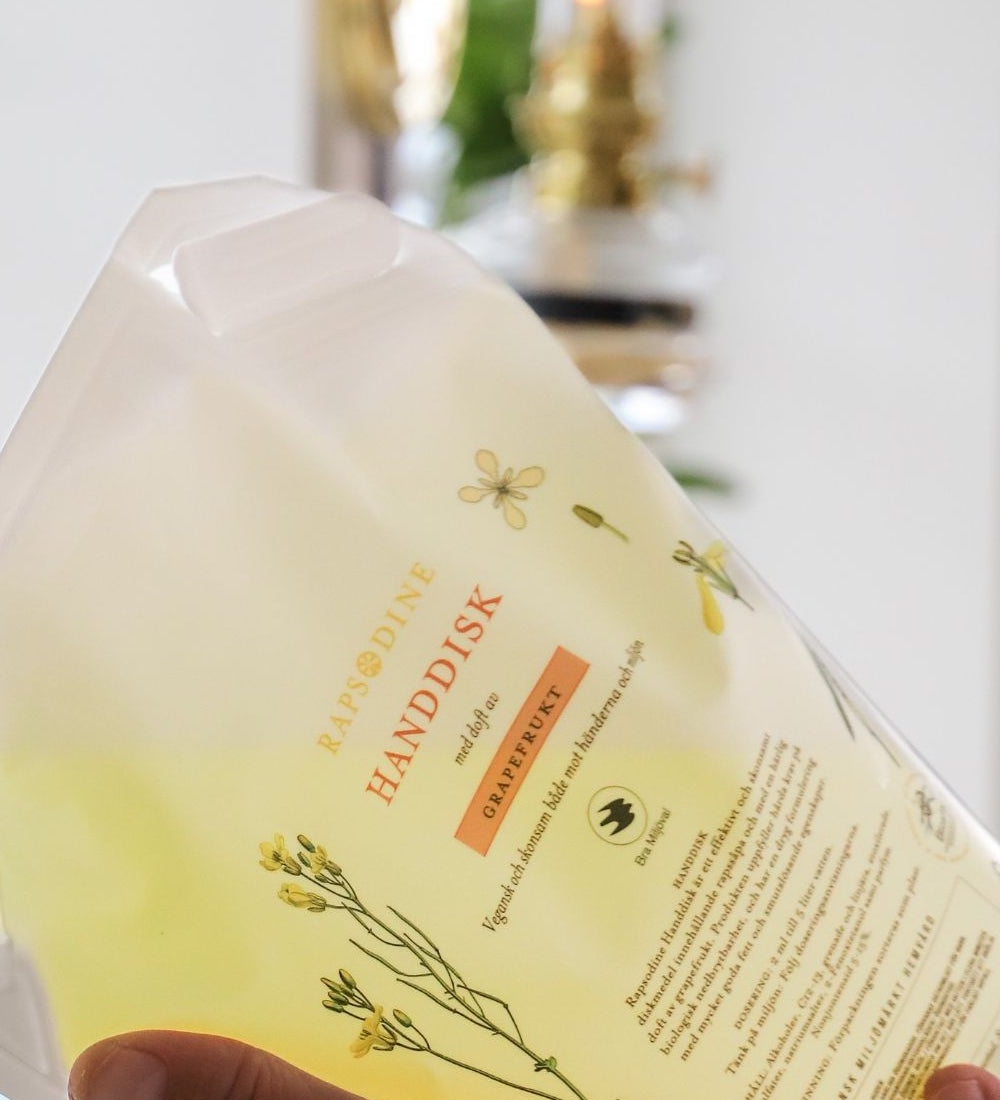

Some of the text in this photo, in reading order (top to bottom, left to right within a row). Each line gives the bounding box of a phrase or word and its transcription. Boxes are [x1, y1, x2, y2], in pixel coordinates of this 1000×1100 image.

[316, 561, 437, 757] RAPSODINE
[365, 584, 504, 806] HANDDISK
[454, 692, 500, 766] med doft av
[481, 639, 646, 932] Vegansk och skonsam både mot händerna och miljön
[482, 684, 563, 819] GRAPEFRUKT
[624, 946, 667, 1009] Rapsodine
[659, 889, 698, 946] Handdisk
[692, 874, 704, 889] är
[701, 857, 714, 874] ett
[709, 809, 741, 857] effektivt
[736, 785, 753, 808] och
[633, 807, 672, 867] Bra Miljöval
[636, 965, 678, 1027] diskmedel
[673, 890, 719, 966] innehållande
[716, 839, 747, 889] rapssåpa
[743, 816, 759, 839] och
[754, 786, 770, 815] med
[765, 773, 776, 789] en
[672, 830, 709, 890] HANDDISK
[647, 1018, 668, 1044] doft
[665, 1003, 676, 1018] av
[709, 874, 750, 936] Produkten
[746, 819, 775, 872] uppfyller
[659, 1003, 699, 1056] biologisk
[745, 892, 761, 914] och
[754, 869, 771, 892] har
[768, 853, 780, 869] en
[680, 1033, 700, 1062] med
[697, 993, 725, 1034] mycket
[722, 963, 742, 995] goda
[737, 940, 755, 963] fett
[751, 918, 767, 940] och
[776, 935, 789, 956] ml
[785, 916, 799, 938] till
[724, 1045, 750, 1075] Tänk
[746, 1028, 759, 1048] på
